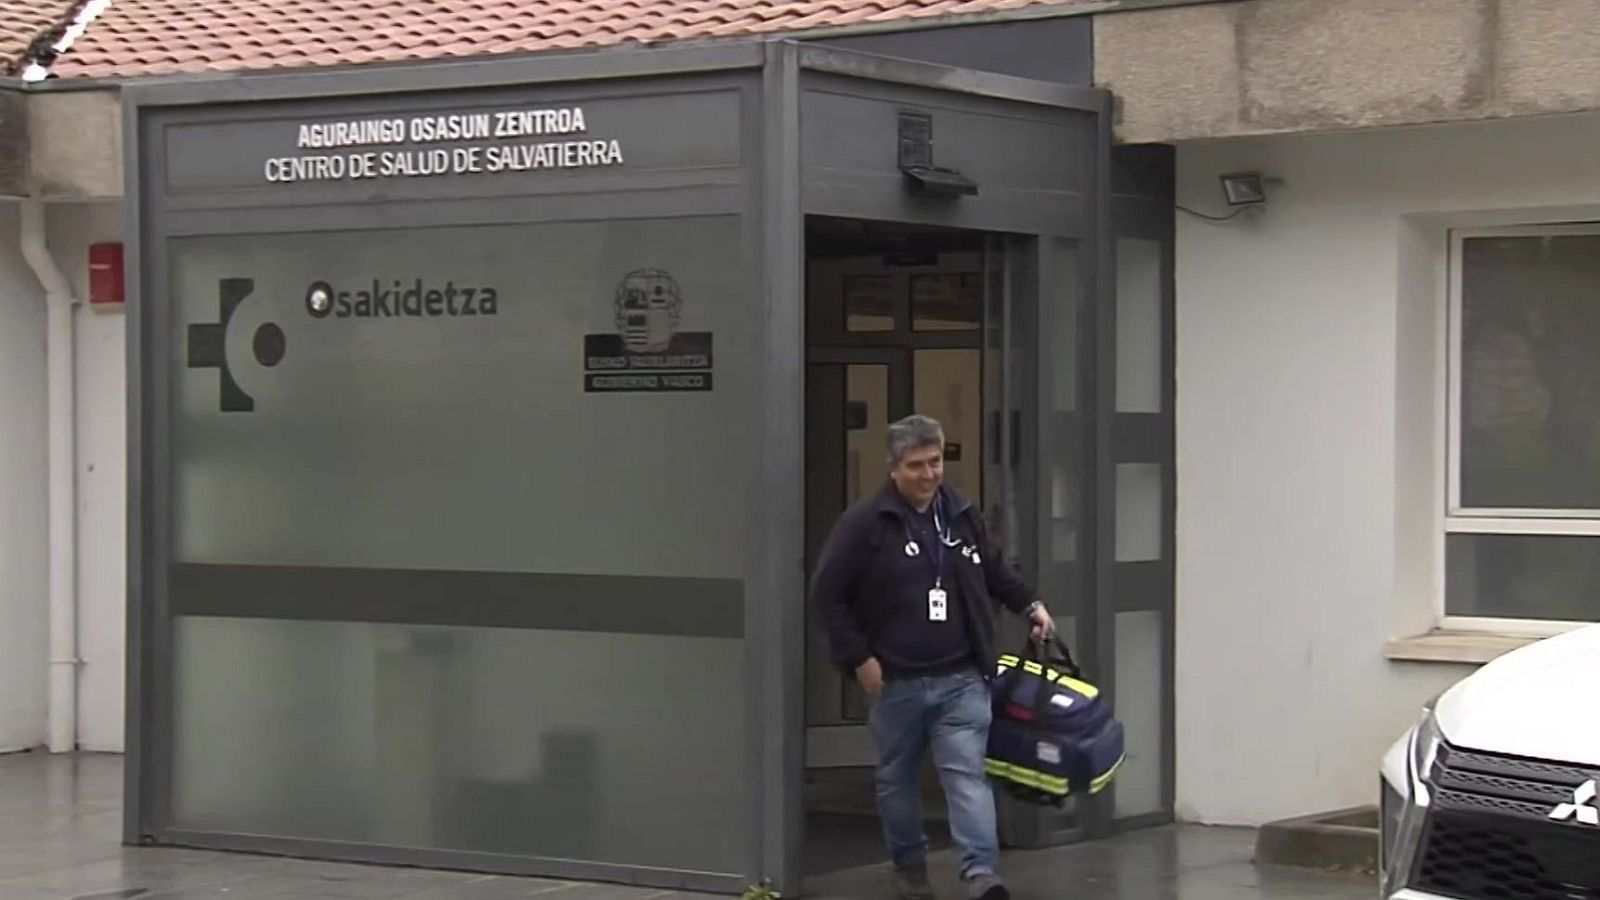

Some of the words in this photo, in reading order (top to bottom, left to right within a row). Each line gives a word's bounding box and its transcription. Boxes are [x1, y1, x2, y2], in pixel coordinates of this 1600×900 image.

[298, 119, 405, 148] AGURAINGO
[410, 114, 489, 143] OSASUN
[494, 107, 586, 137] ZENTROA
[265, 155, 345, 182] CENTRO
[349, 152, 377, 178] DE
[380, 150, 449, 176] SALUD
[453, 147, 482, 173] DE
[486, 139, 623, 172] SALVATIERRA
[305, 278, 498, 319] Osakidetza
